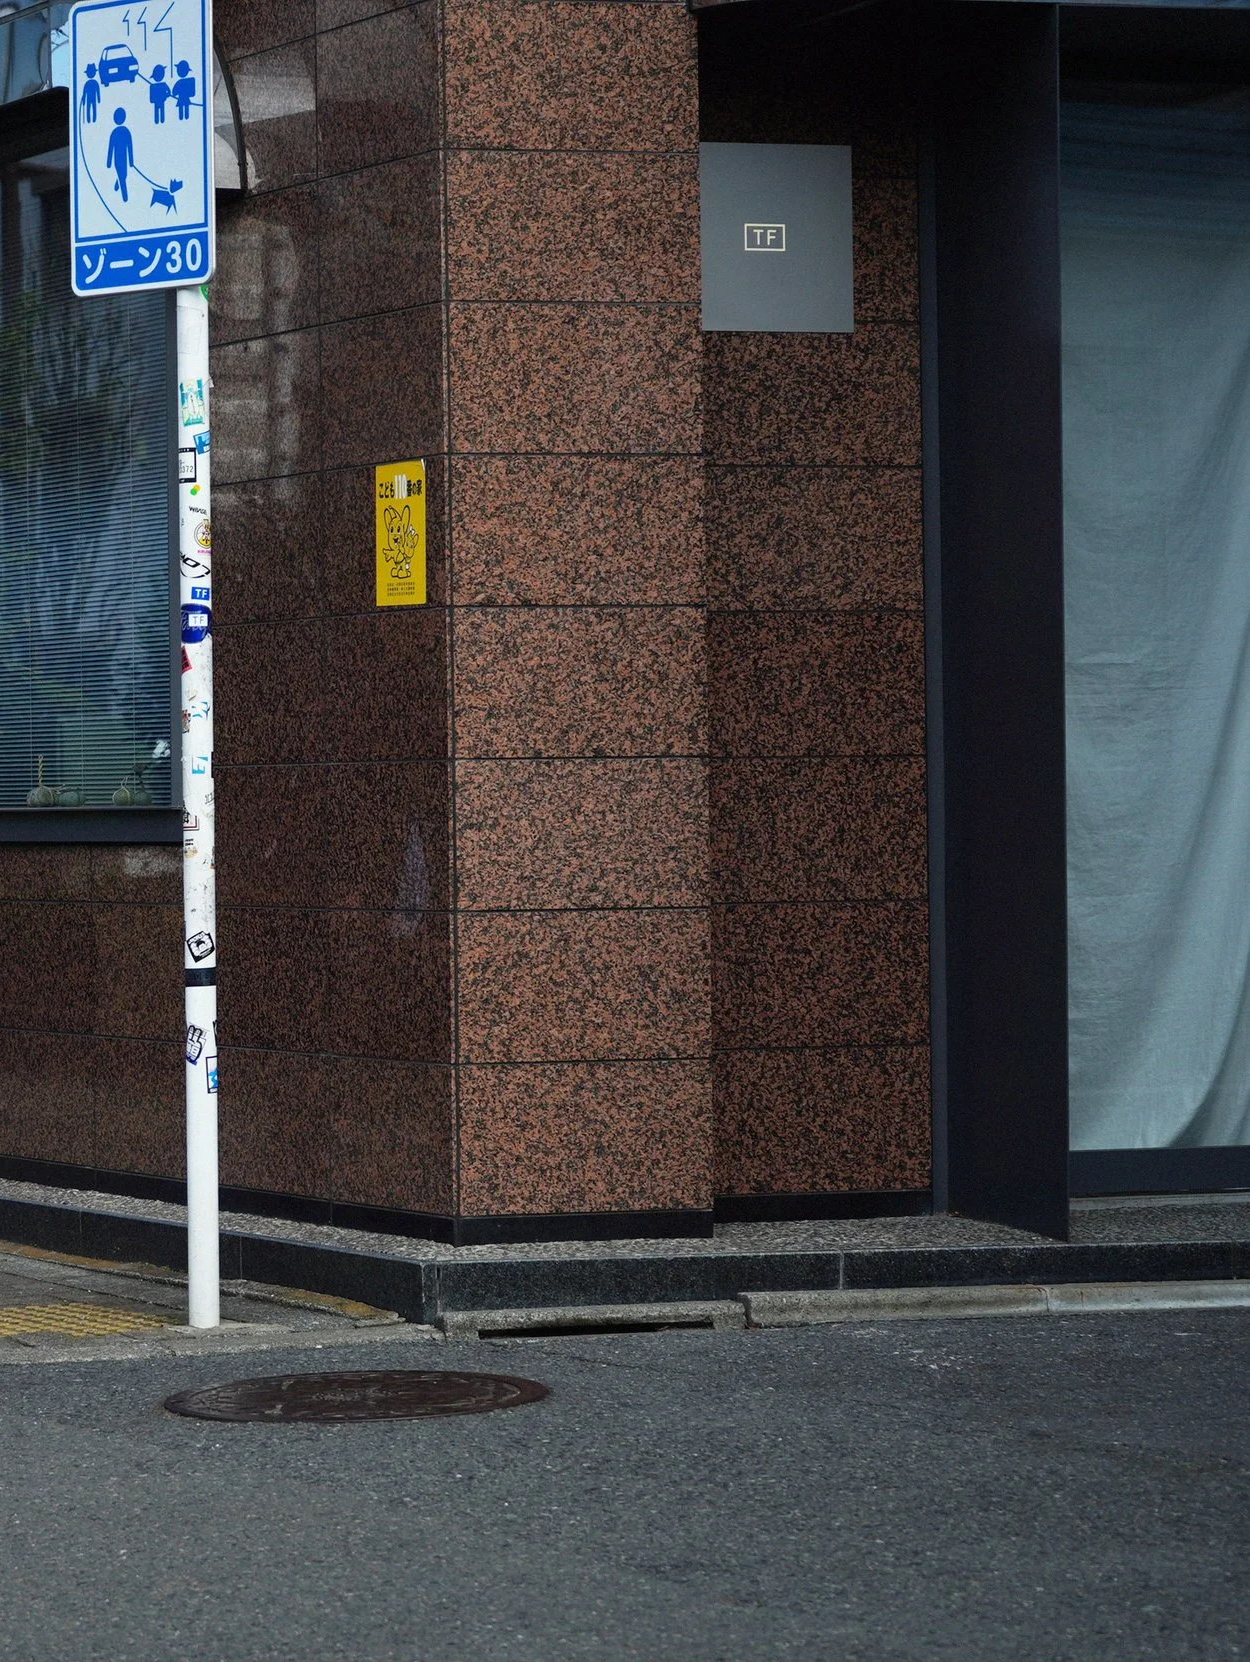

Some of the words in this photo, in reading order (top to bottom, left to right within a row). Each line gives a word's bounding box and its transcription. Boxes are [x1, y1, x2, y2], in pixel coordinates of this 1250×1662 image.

[753, 229, 777, 246] TF
[82, 238, 202, 284] ゾーン30
[195, 588, 208, 599] TF
[192, 615, 205, 625] TF
